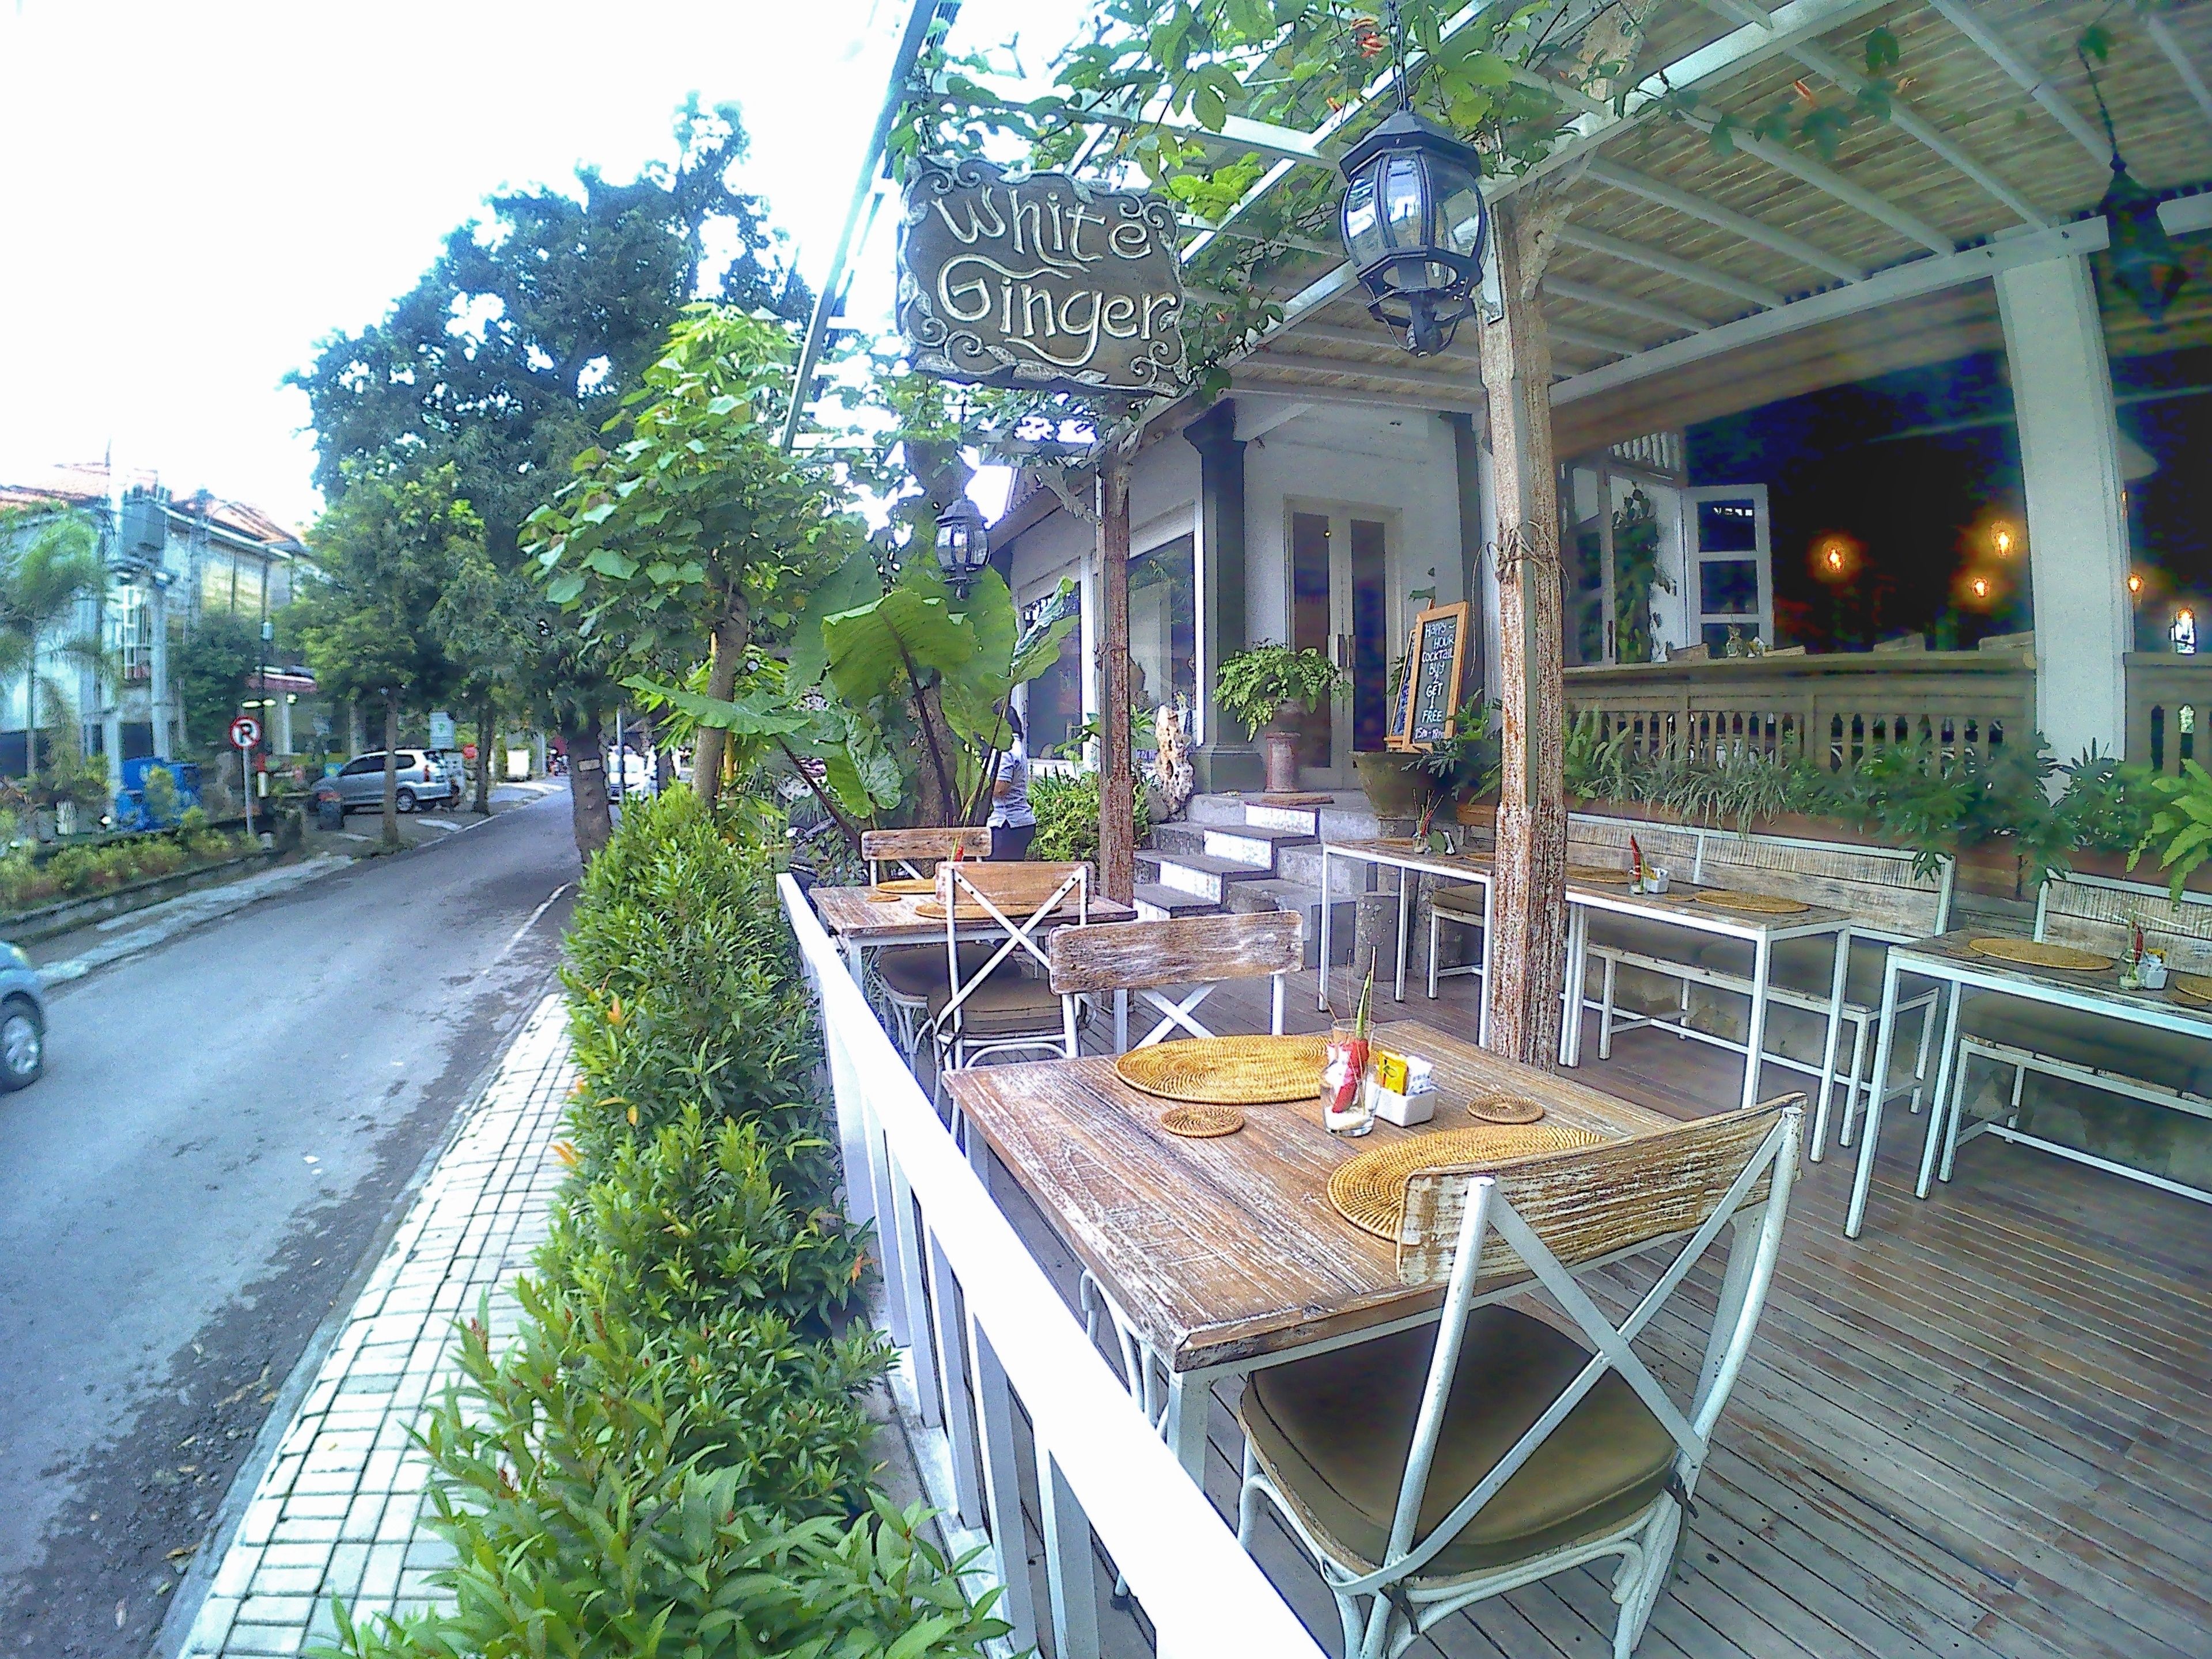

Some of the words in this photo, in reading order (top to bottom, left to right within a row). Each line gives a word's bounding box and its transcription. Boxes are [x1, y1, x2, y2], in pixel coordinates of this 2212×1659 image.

[930, 184, 1152, 273] White
[937, 253, 1176, 368] Ginger
[1425, 622, 1446, 638] Happy
[1433, 634, 1455, 649] HOUR
[1433, 673, 1440, 684] 2
[1426, 683, 1443, 698] GET
[1429, 695, 1434, 709] 1
[1422, 710, 1442, 723] FREE
